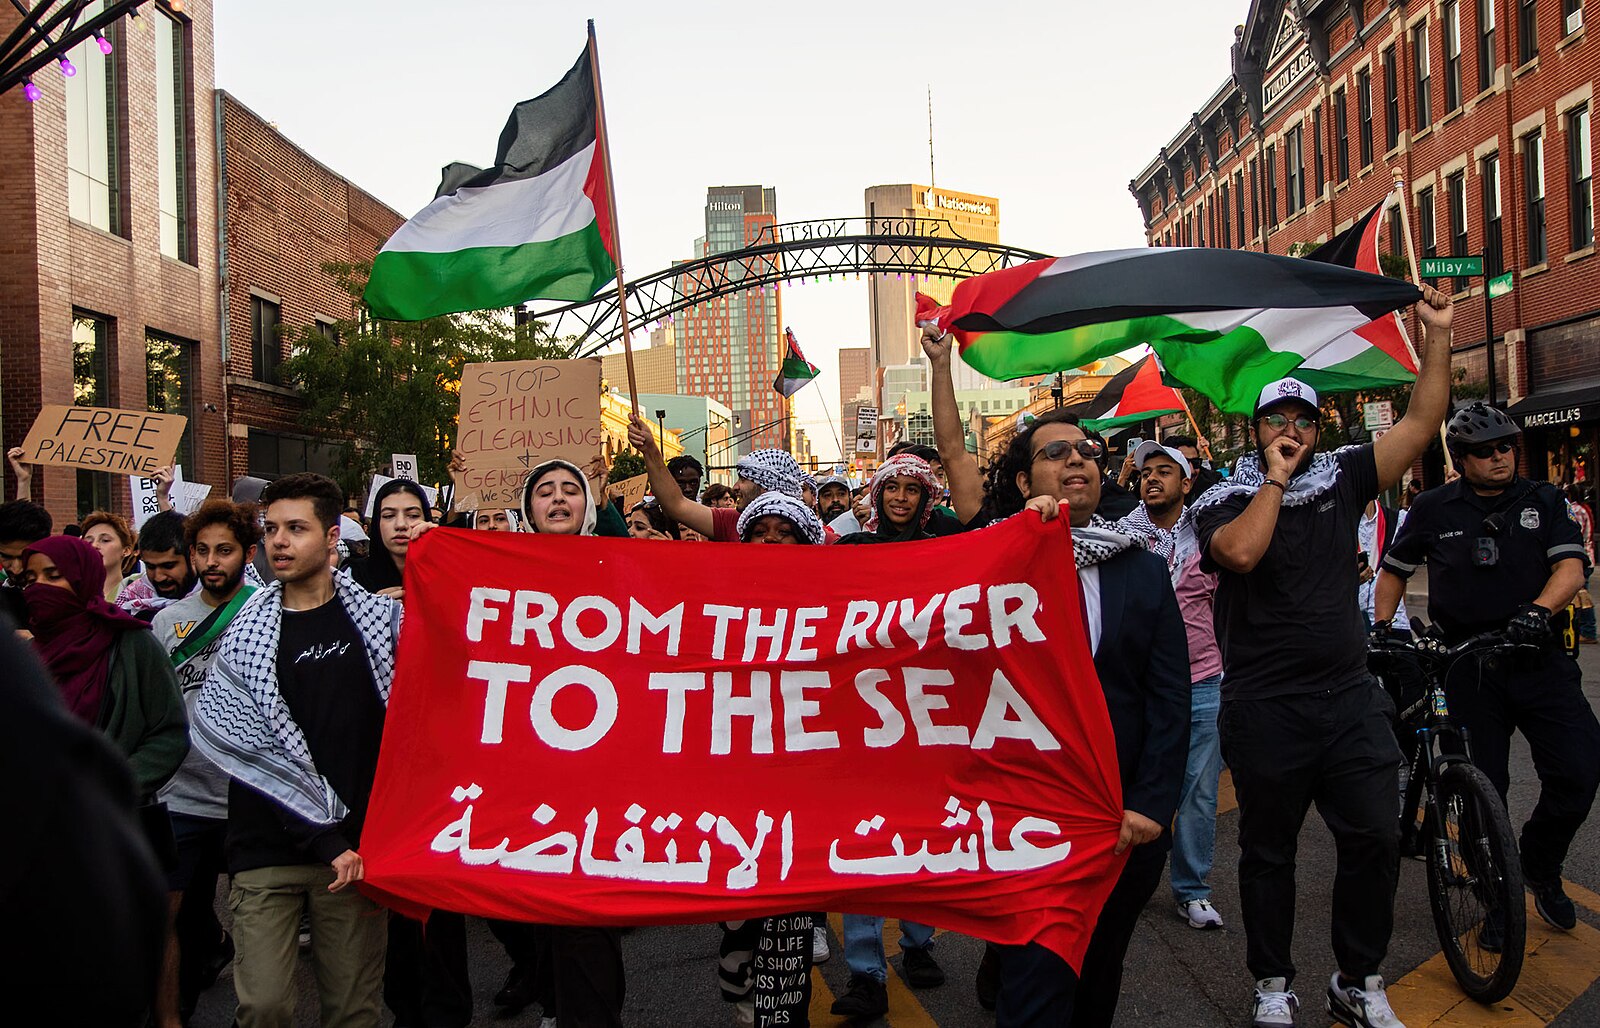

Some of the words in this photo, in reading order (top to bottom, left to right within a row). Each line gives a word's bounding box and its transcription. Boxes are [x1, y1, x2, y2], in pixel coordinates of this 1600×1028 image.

[709, 201, 741, 212] Hilton
[938, 195, 992, 216] Nationwide
[1426, 261, 1463, 275] Milay
[478, 365, 560, 397] STOP
[469, 395, 583, 423] ETHNIC
[1524, 407, 1581, 428] MARCELLA'S
[55, 408, 164, 450] FREE
[461, 426, 601, 454] CLEANSING
[35, 439, 159, 473] PALESTINE
[396, 460, 412, 471] END
[140, 478, 161, 490] EN
[480, 489, 498, 502] We
[466, 586, 684, 656] FROM
[703, 604, 828, 662] THE
[836, 582, 1047, 654] RIVER
[467, 660, 619, 751] TO
[648, 670, 840, 755] THE
[854, 667, 1061, 750] SEA
[430, 782, 793, 889] الانتفاضة
[828, 796, 1072, 876] عاشت
[777, 919, 787, 933] IS
[790, 916, 814, 931] LONG
[777, 936, 804, 952] LIFE
